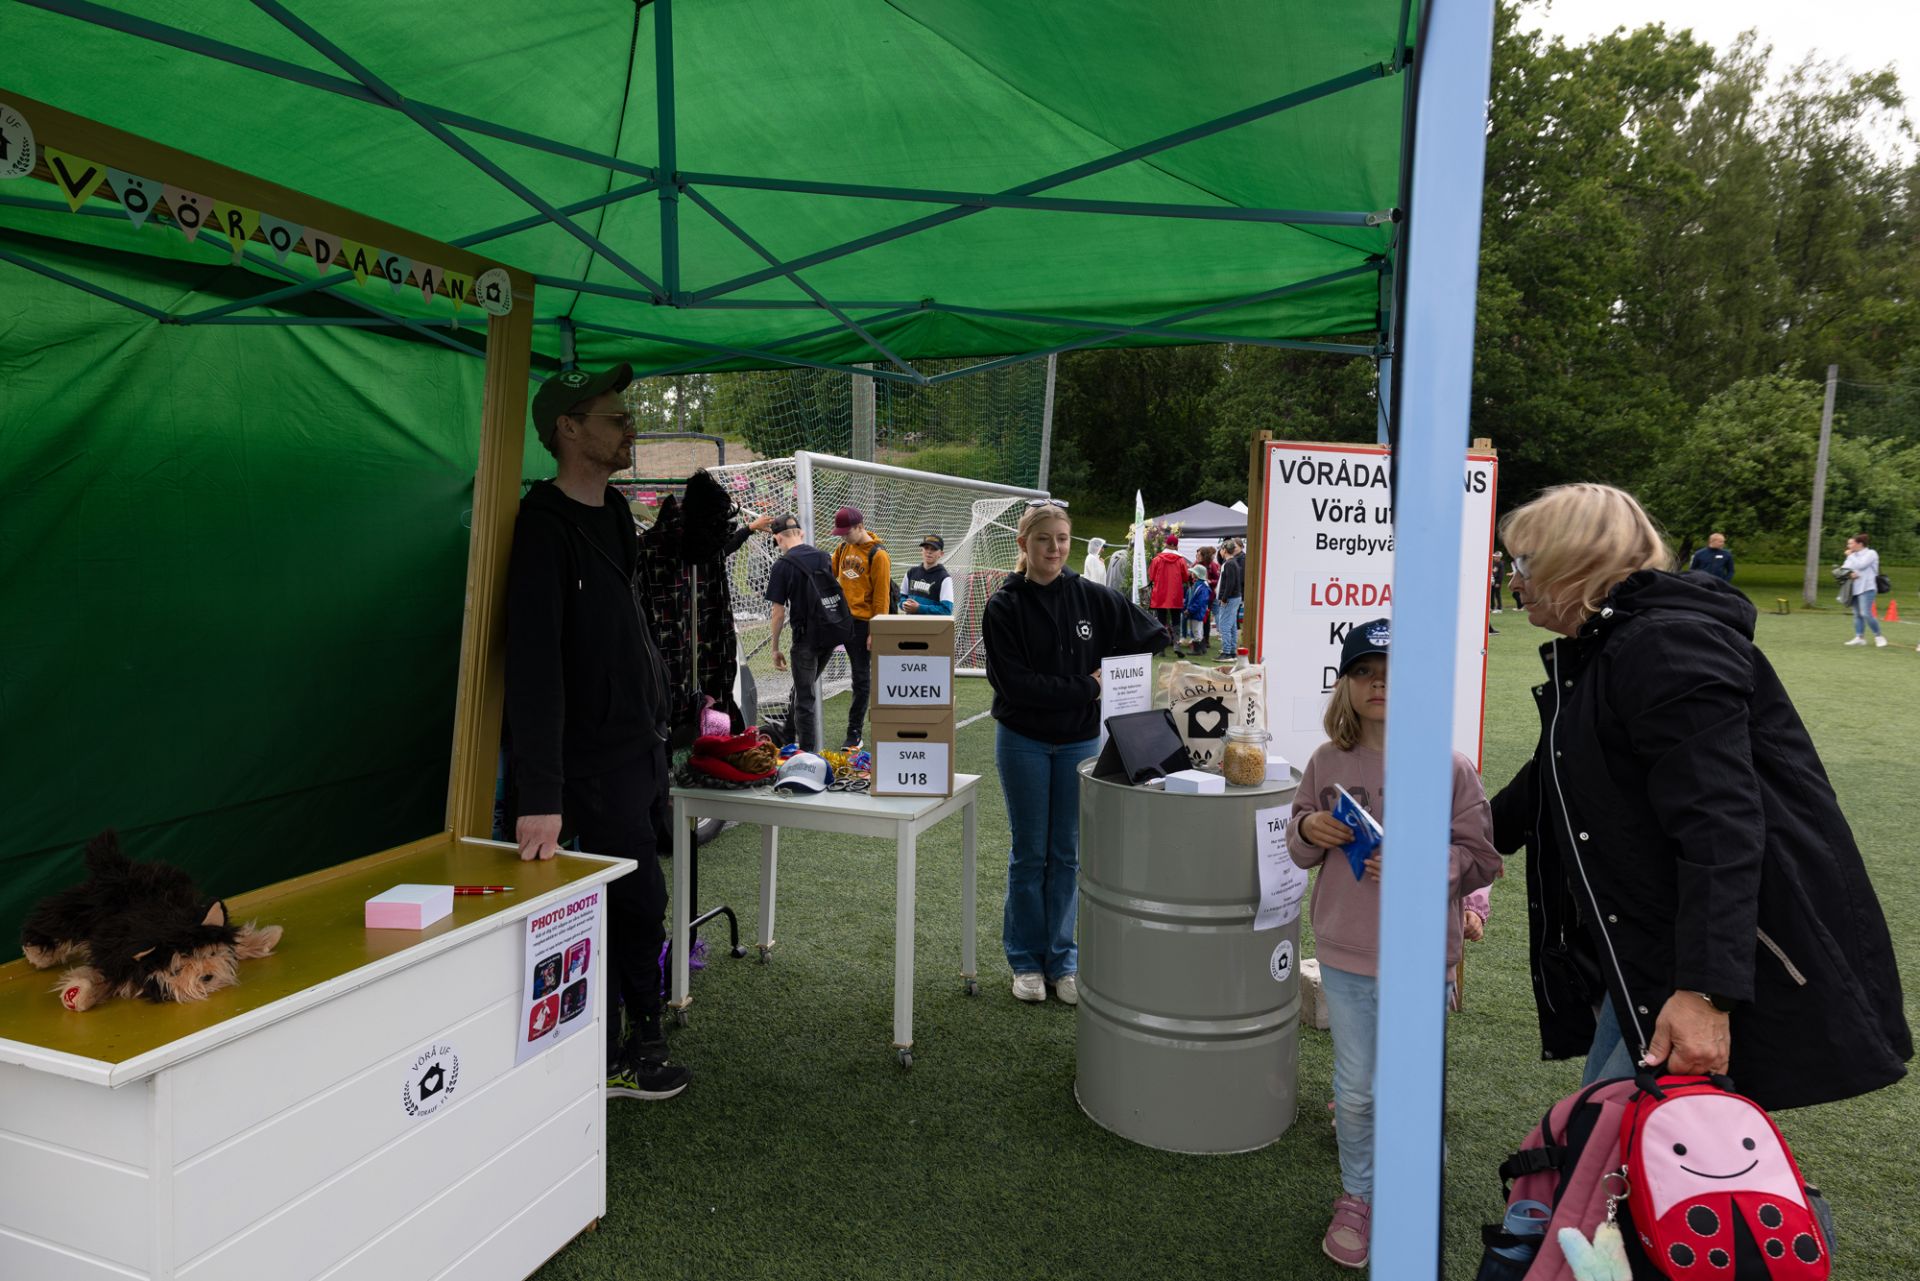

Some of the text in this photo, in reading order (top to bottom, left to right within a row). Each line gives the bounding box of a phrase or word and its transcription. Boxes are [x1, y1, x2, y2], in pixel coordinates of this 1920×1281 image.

[1311, 498, 1367, 524] Vörå
[1316, 533, 1395, 556] Bergbyvä
[1310, 577, 1393, 607] LÖRDA
[901, 663, 927, 672] SVAR
[1110, 667, 1144, 680] TÄVLING
[886, 685, 941, 698] VUXEN
[899, 751, 926, 760] SVAR
[898, 772, 927, 786] U18
[531, 907, 566, 933] PHOTO
[566, 893, 599, 917] BOOTH
